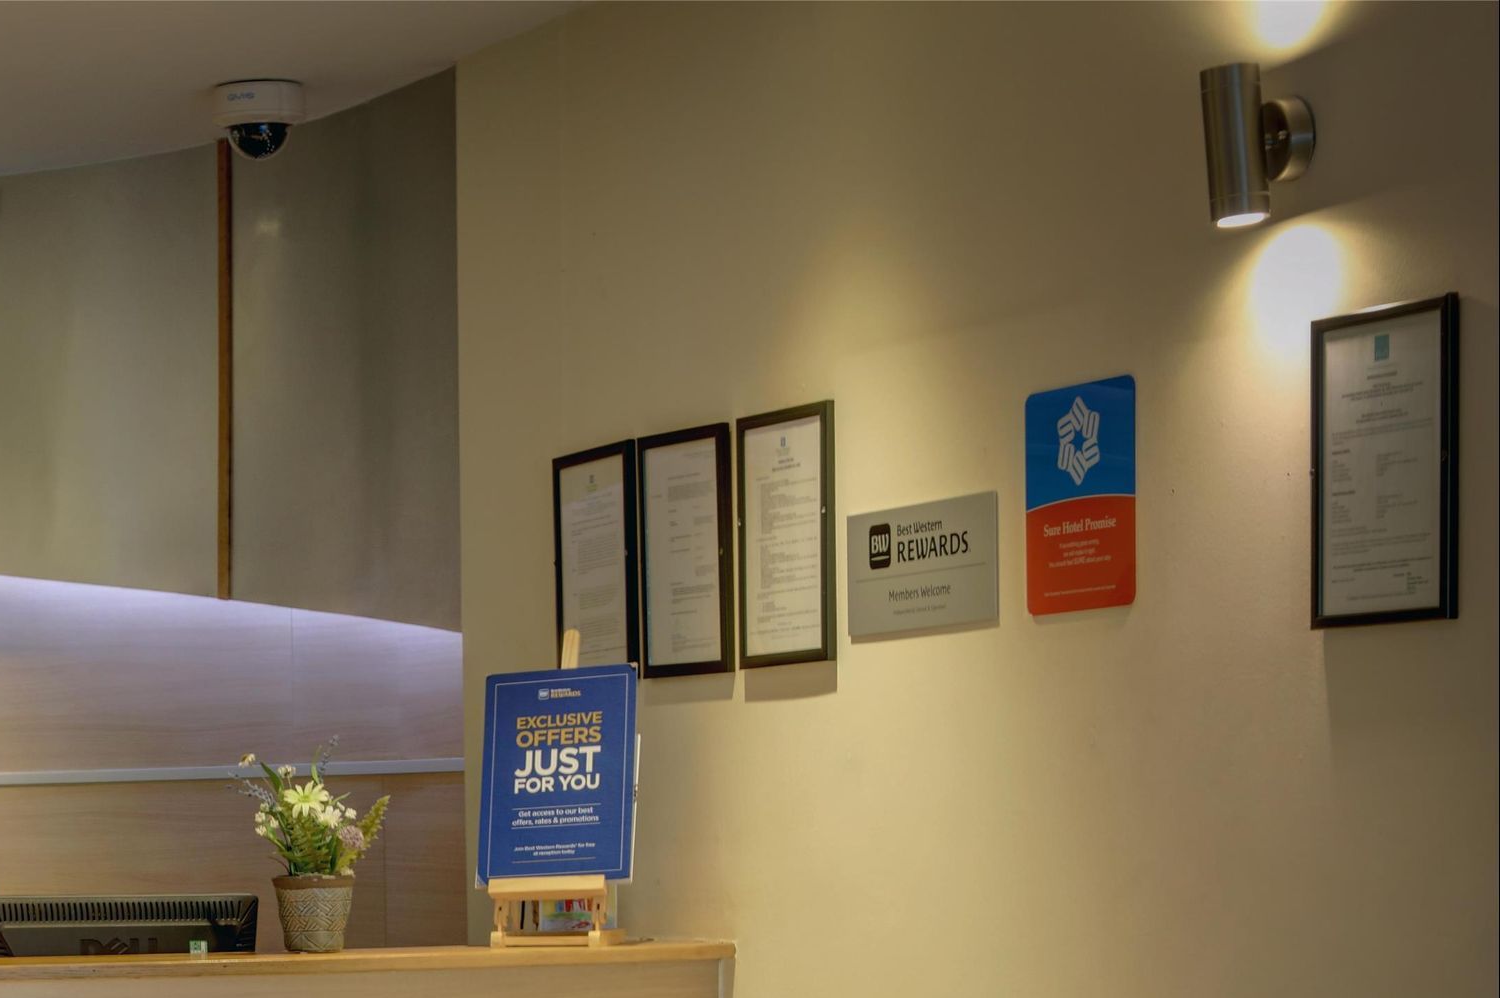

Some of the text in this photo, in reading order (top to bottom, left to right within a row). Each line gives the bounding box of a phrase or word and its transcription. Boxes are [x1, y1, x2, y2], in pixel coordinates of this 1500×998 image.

[896, 520, 943, 537] Best Western
[1043, 515, 1117, 537] Sure Hotel Promise
[871, 533, 889, 554] BW
[897, 530, 970, 564] REWARDS
[888, 583, 952, 602] Members Welcome
[516, 711, 602, 730] EXCLUSIVE
[515, 726, 602, 748] OFFERS
[514, 745, 602, 778] JUST
[514, 773, 601, 795] FOR YOU
[578, 806, 593, 814] best
[512, 819, 534, 827] offers,
[560, 815, 599, 825] promotions
